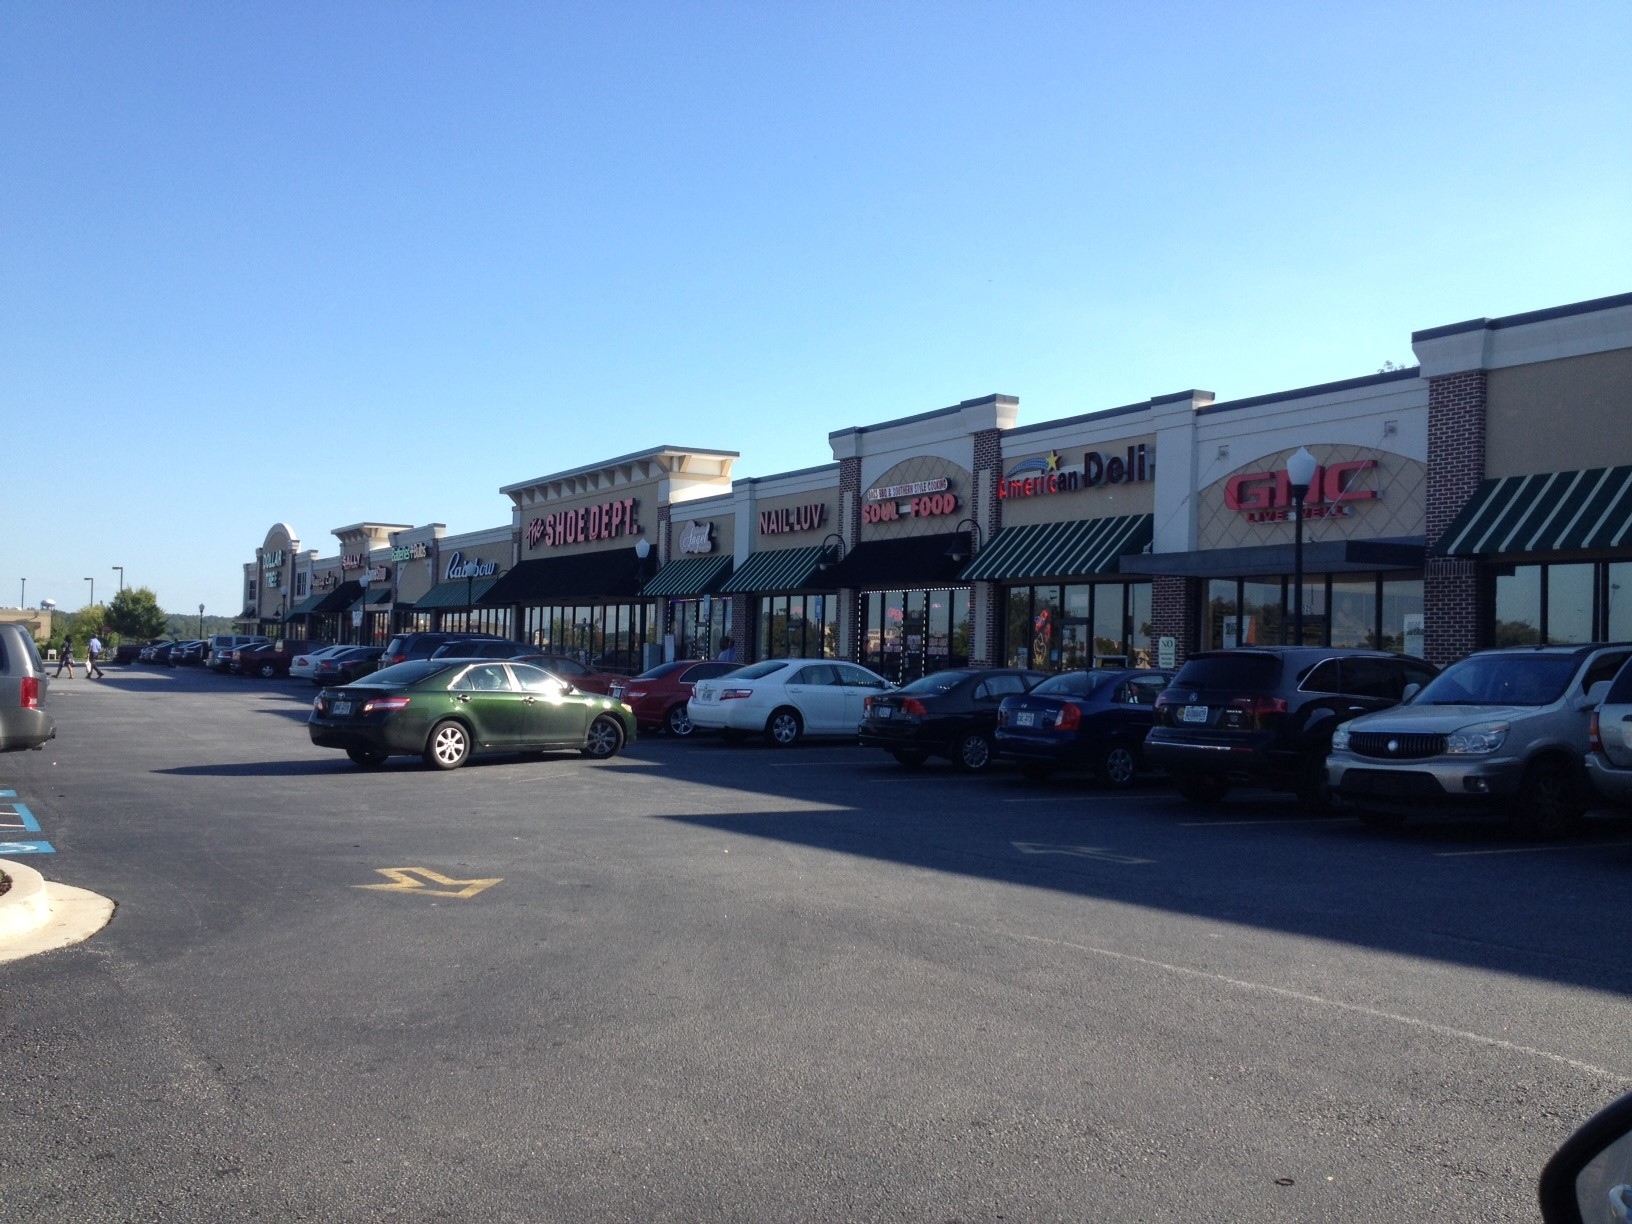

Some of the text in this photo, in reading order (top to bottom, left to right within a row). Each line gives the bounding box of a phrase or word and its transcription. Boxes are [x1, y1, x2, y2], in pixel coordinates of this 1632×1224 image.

[996, 443, 1146, 500] American Deli
[1224, 458, 1379, 511] GNC
[893, 483, 914, 496] SOUTHERN
[914, 481, 927, 493] STYLE
[928, 478, 947, 491] COOKING
[545, 507, 587, 547] SHOE
[589, 497, 640, 541] DEPT.
[758, 503, 824, 535] NAIL LUV
[861, 493, 956, 524] SOUL FOOD
[1247, 510, 1287, 524] LIVE
[263, 549, 283, 569] DOLLAR
[342, 553, 361, 566] SALLY
[444, 551, 495, 580] Raibow
[1161, 639, 1174, 648] NO
